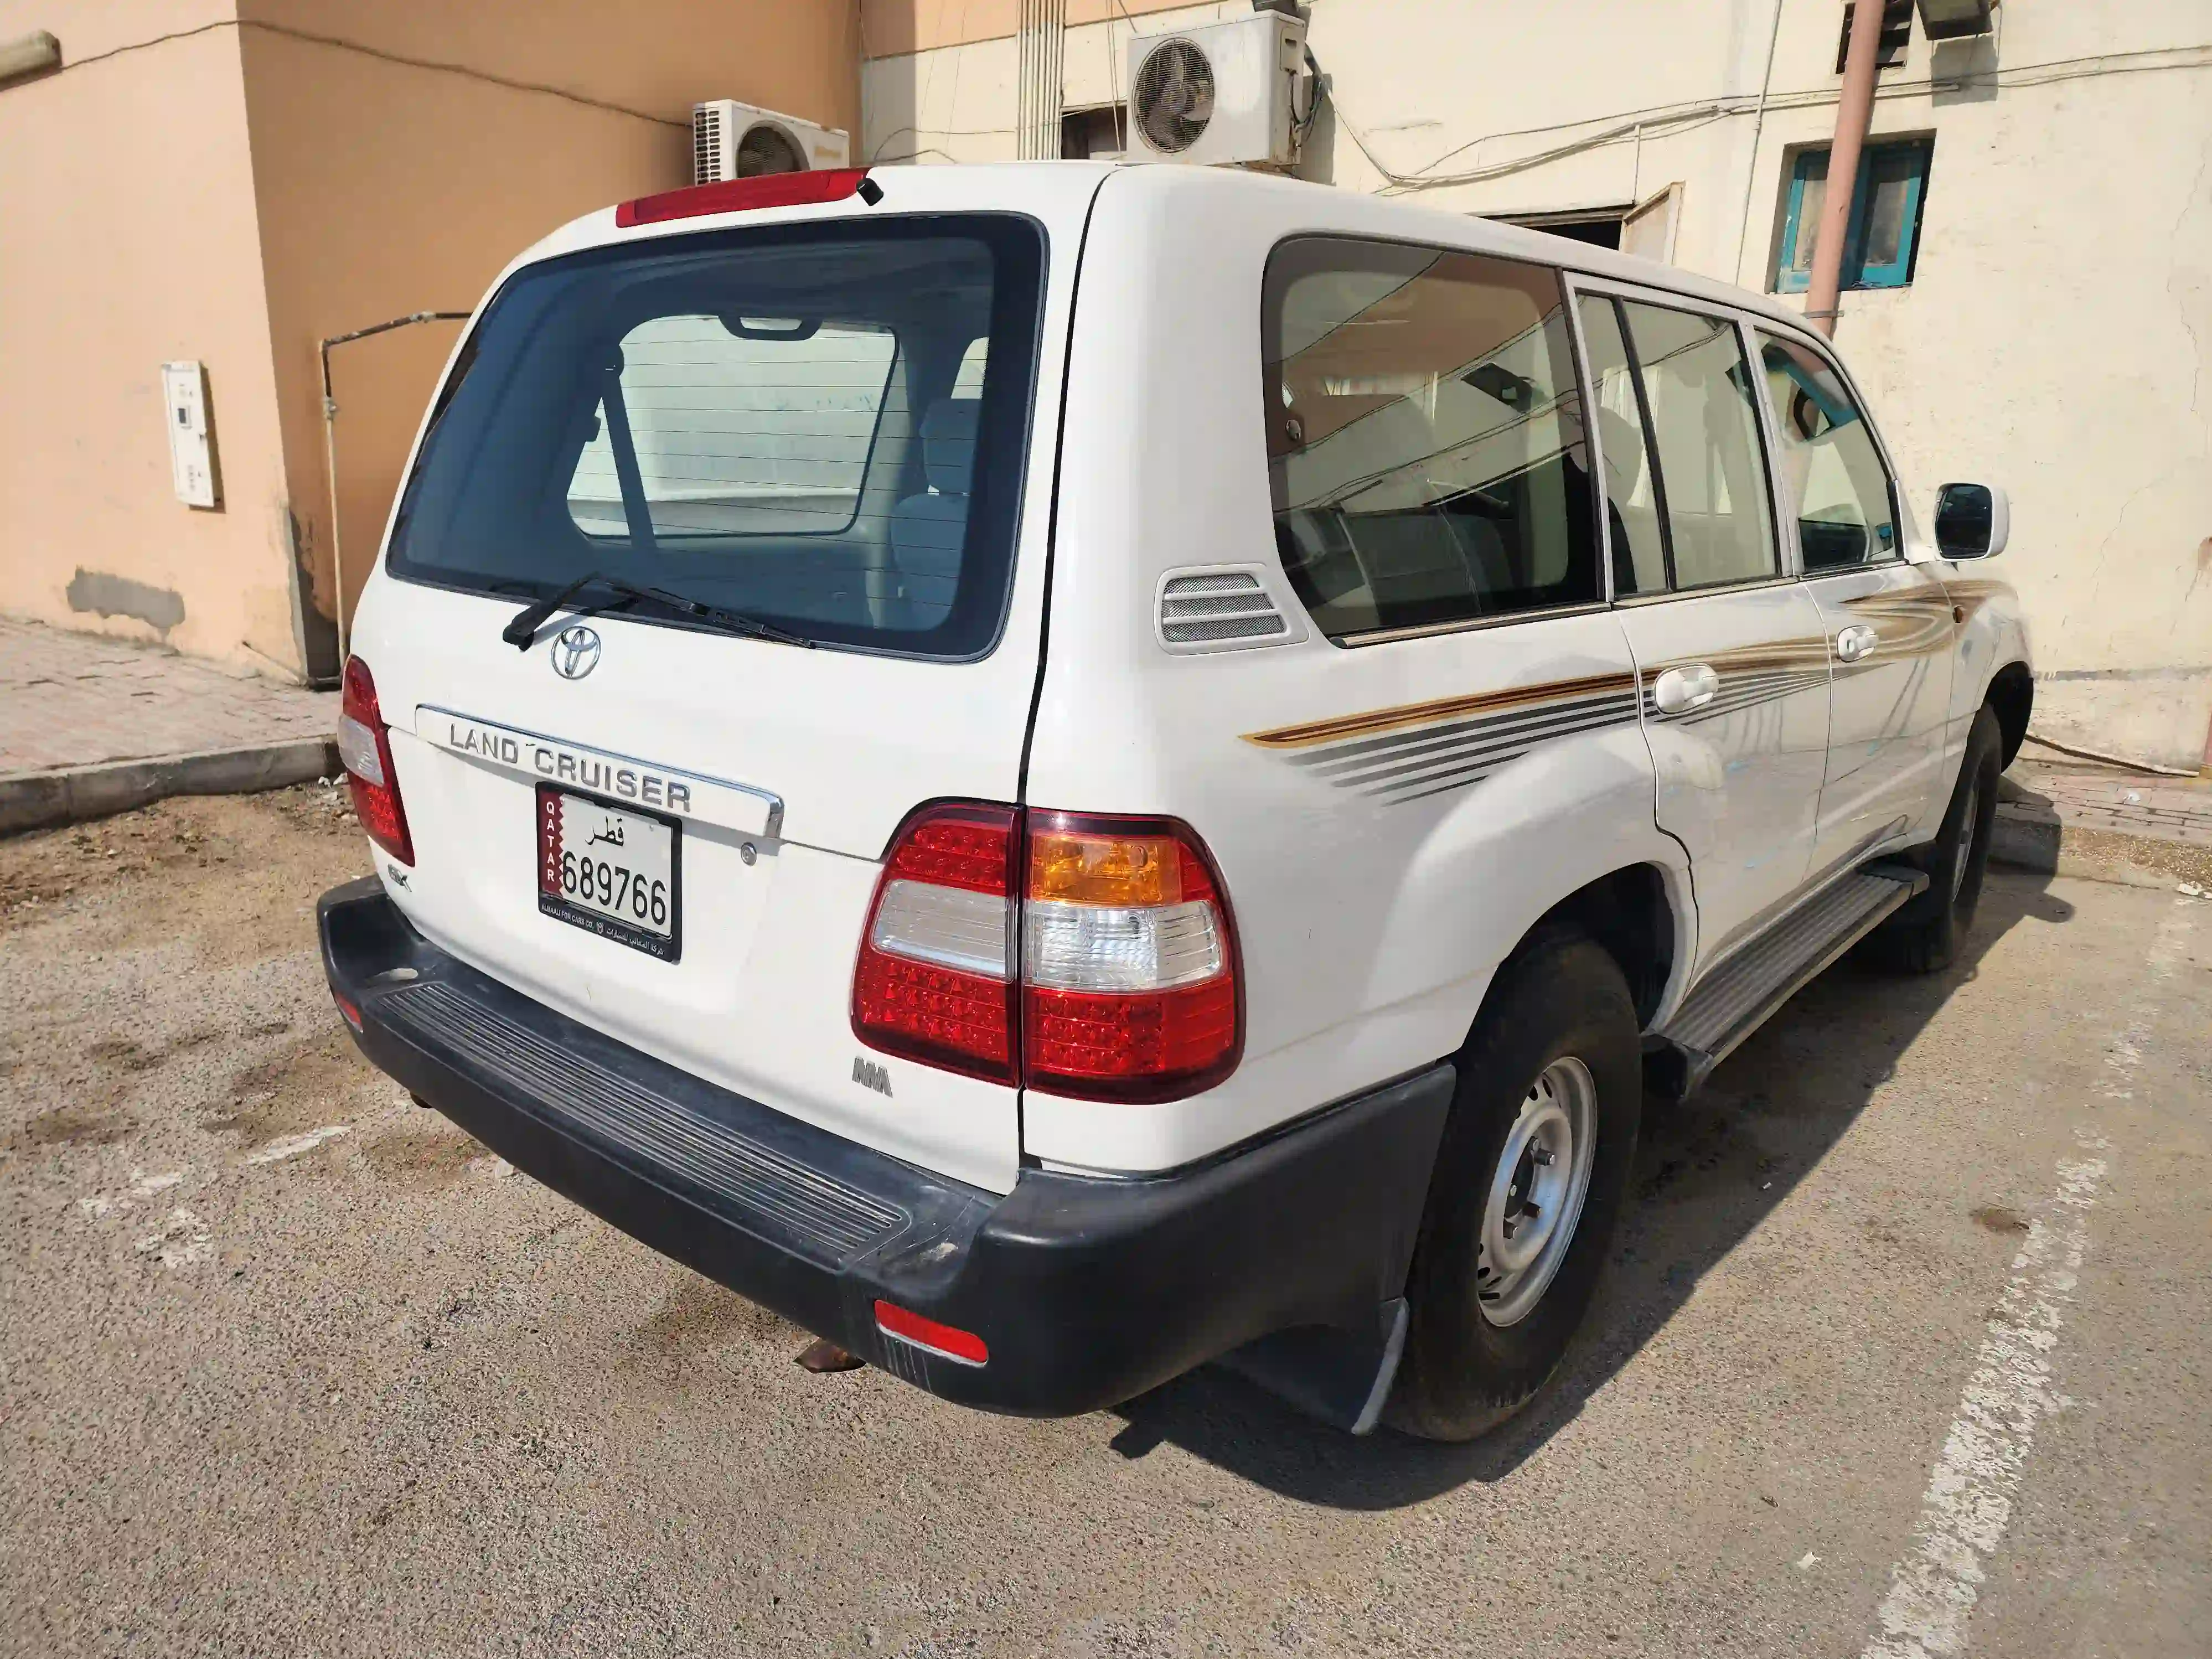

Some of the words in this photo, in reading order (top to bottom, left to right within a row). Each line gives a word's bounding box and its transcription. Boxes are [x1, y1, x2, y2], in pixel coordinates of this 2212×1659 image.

[449, 723, 518, 764] LAND
[535, 747, 691, 813] CRUISER
[546, 800, 555, 882] QATAR
[585, 815, 624, 846] قطر
[561, 911, 572, 921] FOR
[571, 916, 585, 926] CARS
[562, 851, 666, 926] 689766
